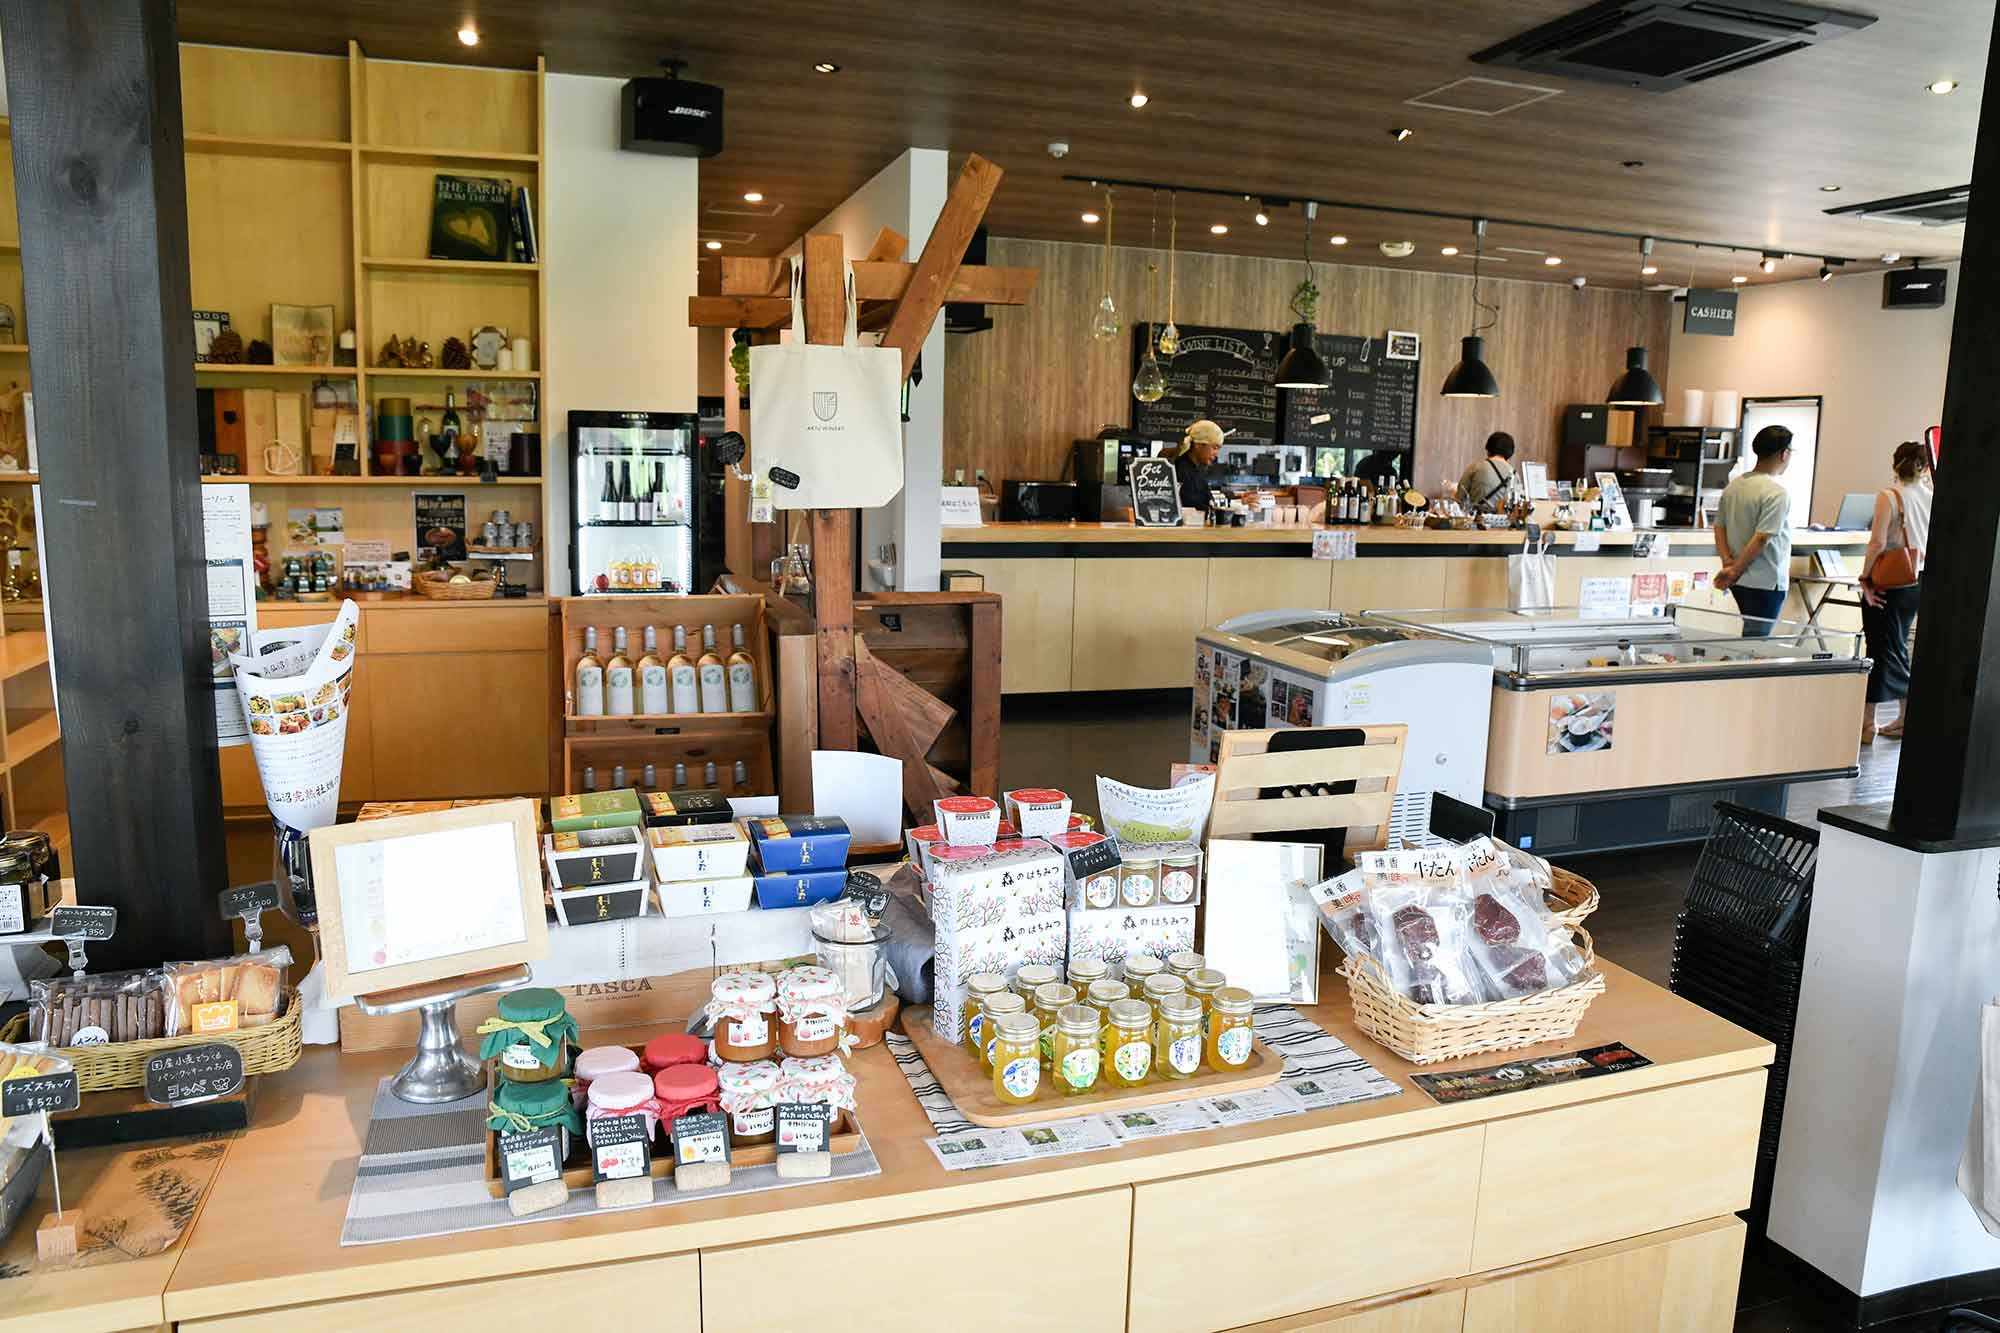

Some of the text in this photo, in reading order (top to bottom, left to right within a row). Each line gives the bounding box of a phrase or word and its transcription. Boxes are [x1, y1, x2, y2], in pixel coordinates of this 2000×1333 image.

[439, 180, 511, 195] THE EARTH
[438, 191, 466, 201] FROM
[468, 192, 487, 202] THE
[1690, 306, 1734, 321] CASHIER
[1183, 338, 1209, 350] WINE
[1140, 462, 1162, 476] Get
[1137, 475, 1170, 488] Drink
[1001, 866, 1060, 888] 森のはちみつ
[1122, 915, 1189, 930] 森のはちみつ
[1002, 920, 1061, 943] 森のはちみつ
[571, 976, 653, 996] TASCA
[6, 1079, 72, 1096] チーズスティック
[27, 1095, 62, 1110] ¥520
[795, 1132, 822, 1140] いちじく
[702, 1145, 721, 1155] うめ
